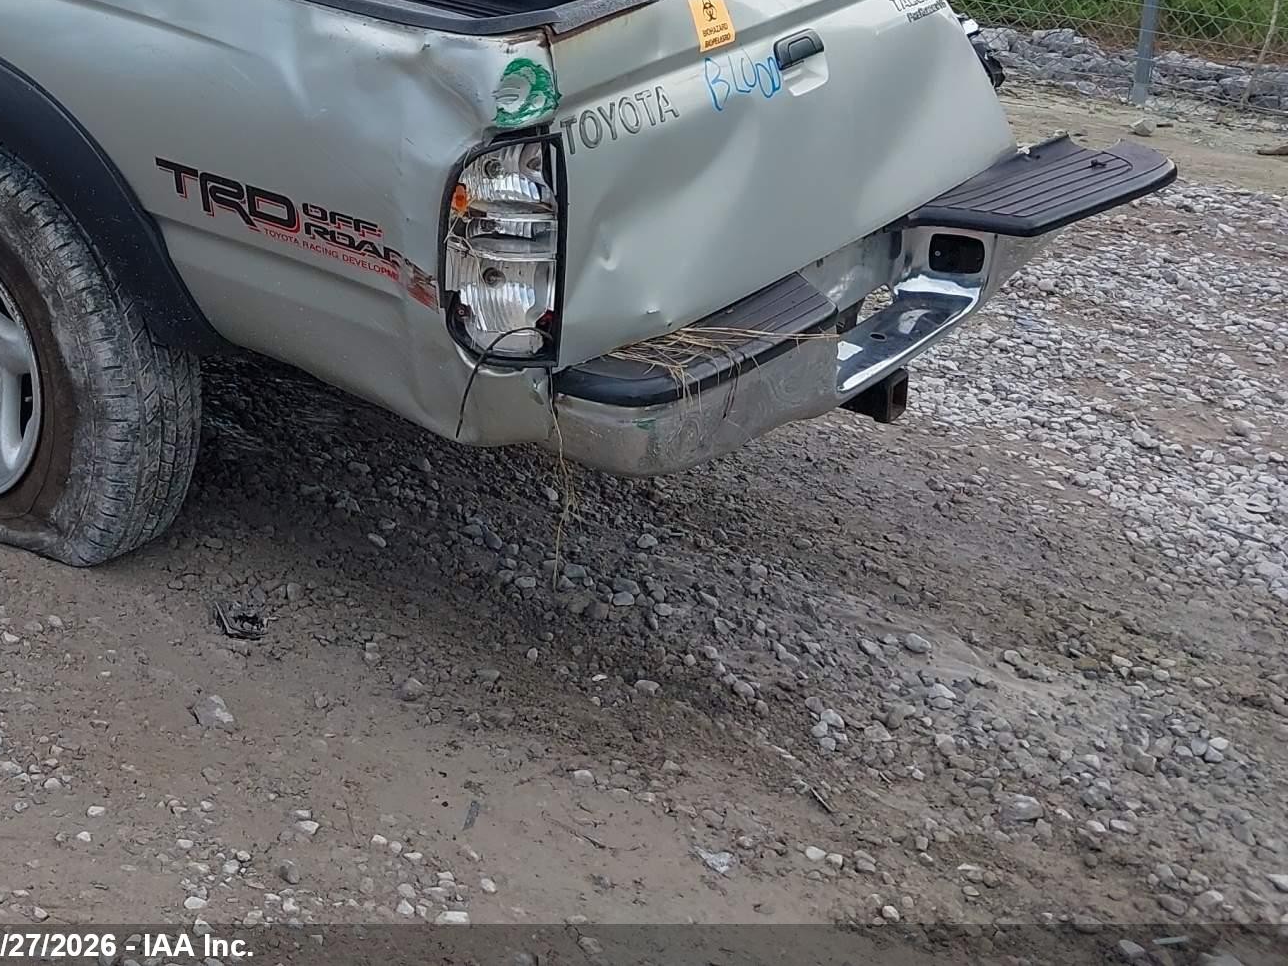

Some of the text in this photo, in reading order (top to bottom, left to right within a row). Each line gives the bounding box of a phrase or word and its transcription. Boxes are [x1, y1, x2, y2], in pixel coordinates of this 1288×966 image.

[702, 23, 729, 37] BIOHAZARD
[560, 85, 680, 155] TOYOTA
[155, 156, 300, 232] TRD
[302, 202, 383, 237] OFF
[264, 228, 300, 245] TOYOTA
[302, 240, 339, 259] RACING
